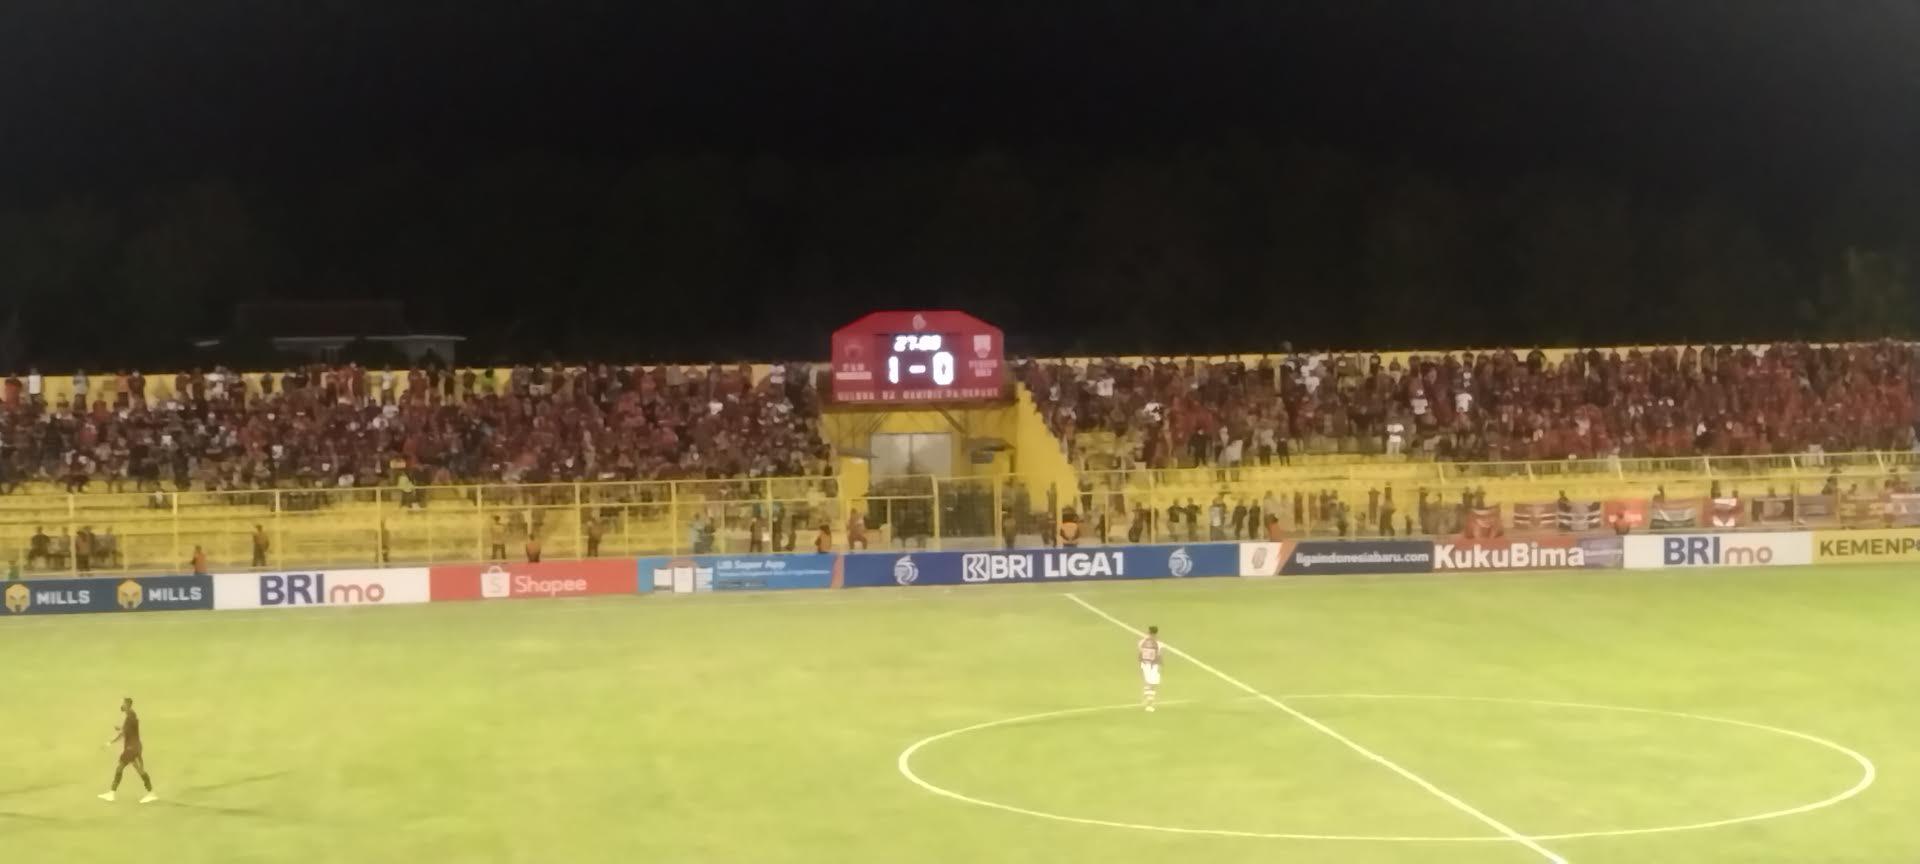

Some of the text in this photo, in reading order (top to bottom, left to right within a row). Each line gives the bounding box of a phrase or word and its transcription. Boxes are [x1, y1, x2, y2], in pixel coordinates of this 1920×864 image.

[888, 356, 899, 384] 1
[932, 352, 954, 385] 0
[991, 554, 1033, 579] BRI
[1296, 551, 1429, 567] ligaindonesiabaru.com
[1434, 543, 1585, 569] KukuBima
[149, 586, 202, 601] MILLS
[515, 575, 587, 597] Shopee
[36, 590, 91, 605] MILLS
